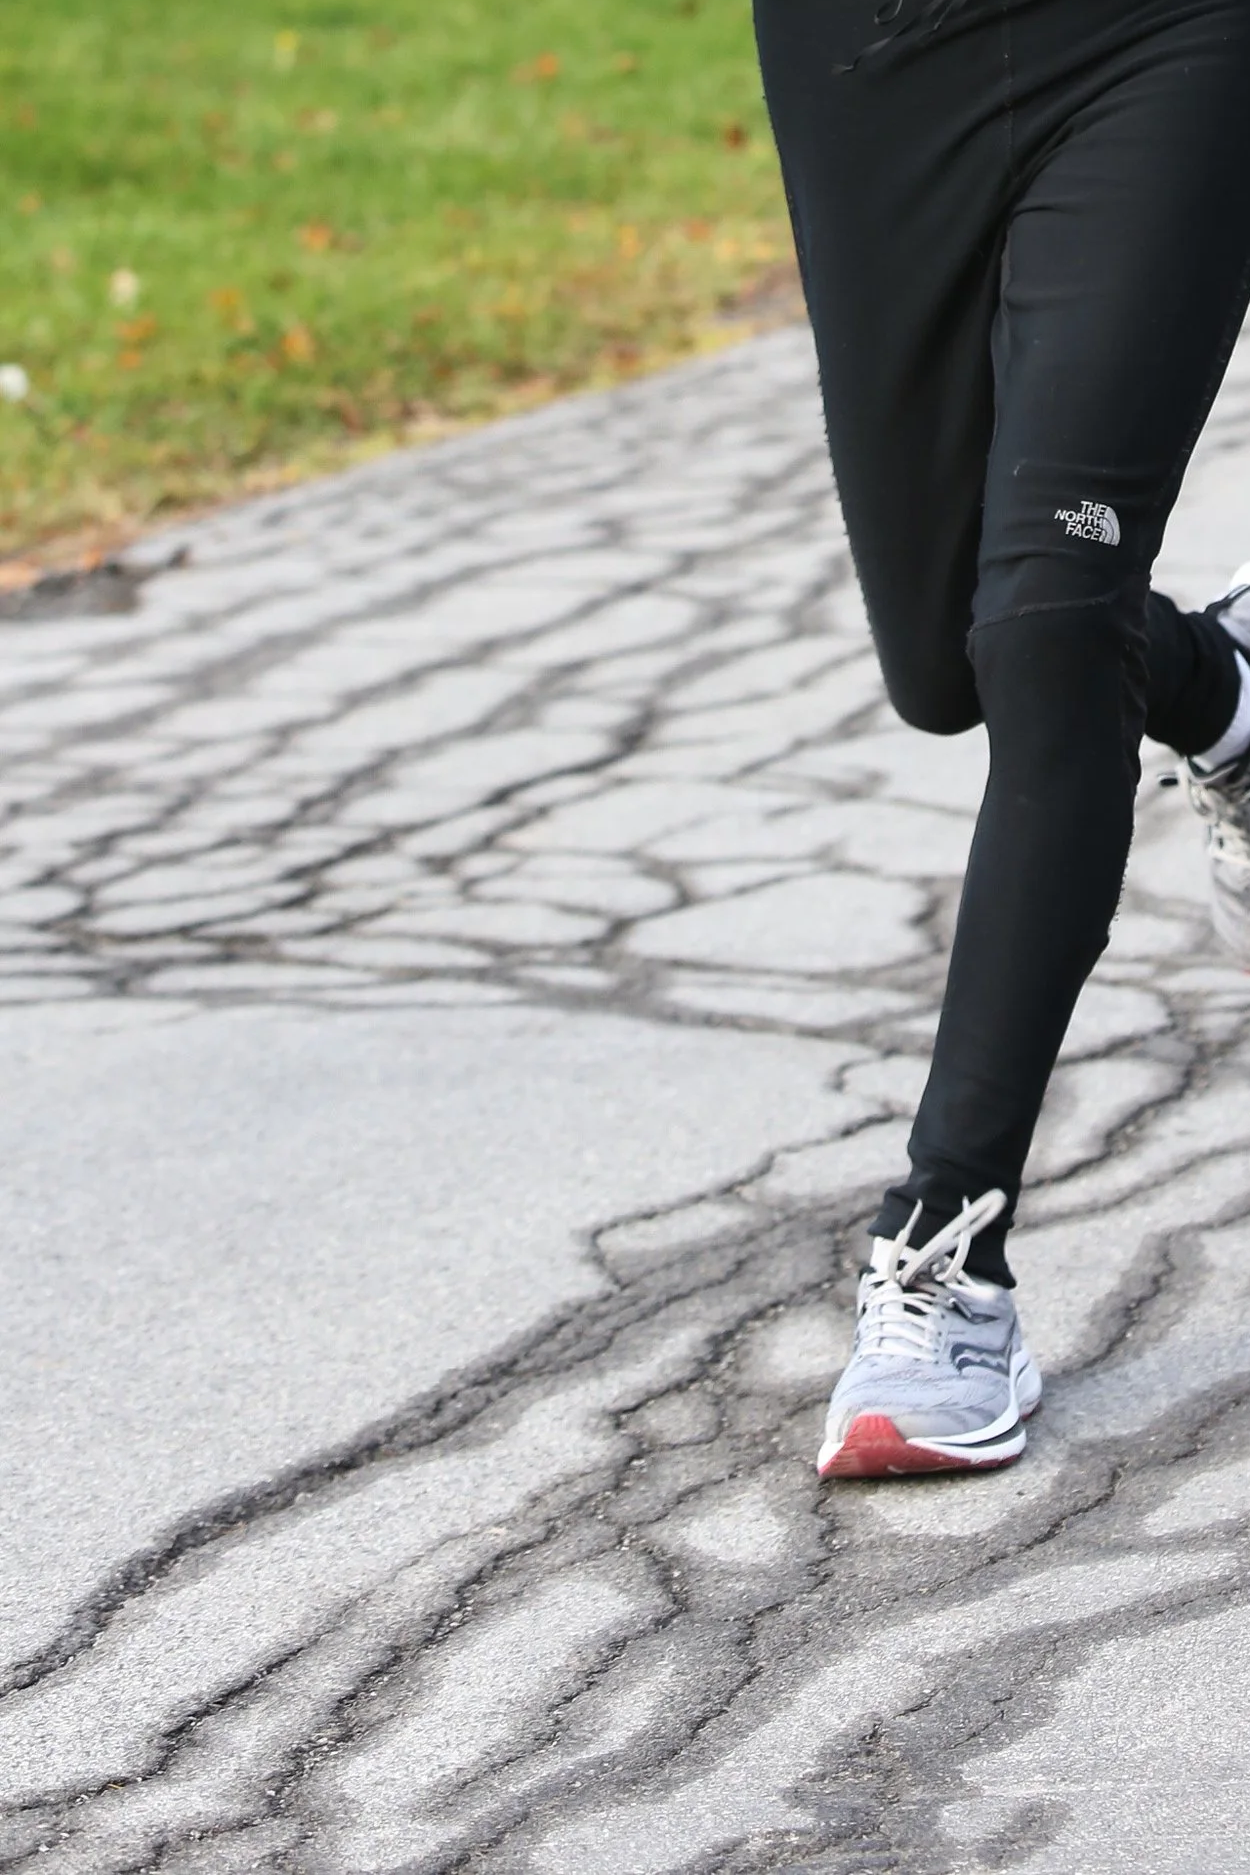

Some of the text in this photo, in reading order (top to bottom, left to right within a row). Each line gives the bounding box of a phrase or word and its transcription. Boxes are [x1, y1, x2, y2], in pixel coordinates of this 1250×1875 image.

[1081, 501, 1107, 517] THE
[1054, 509, 1103, 528] NORTH
[1065, 522, 1101, 540] FACE
